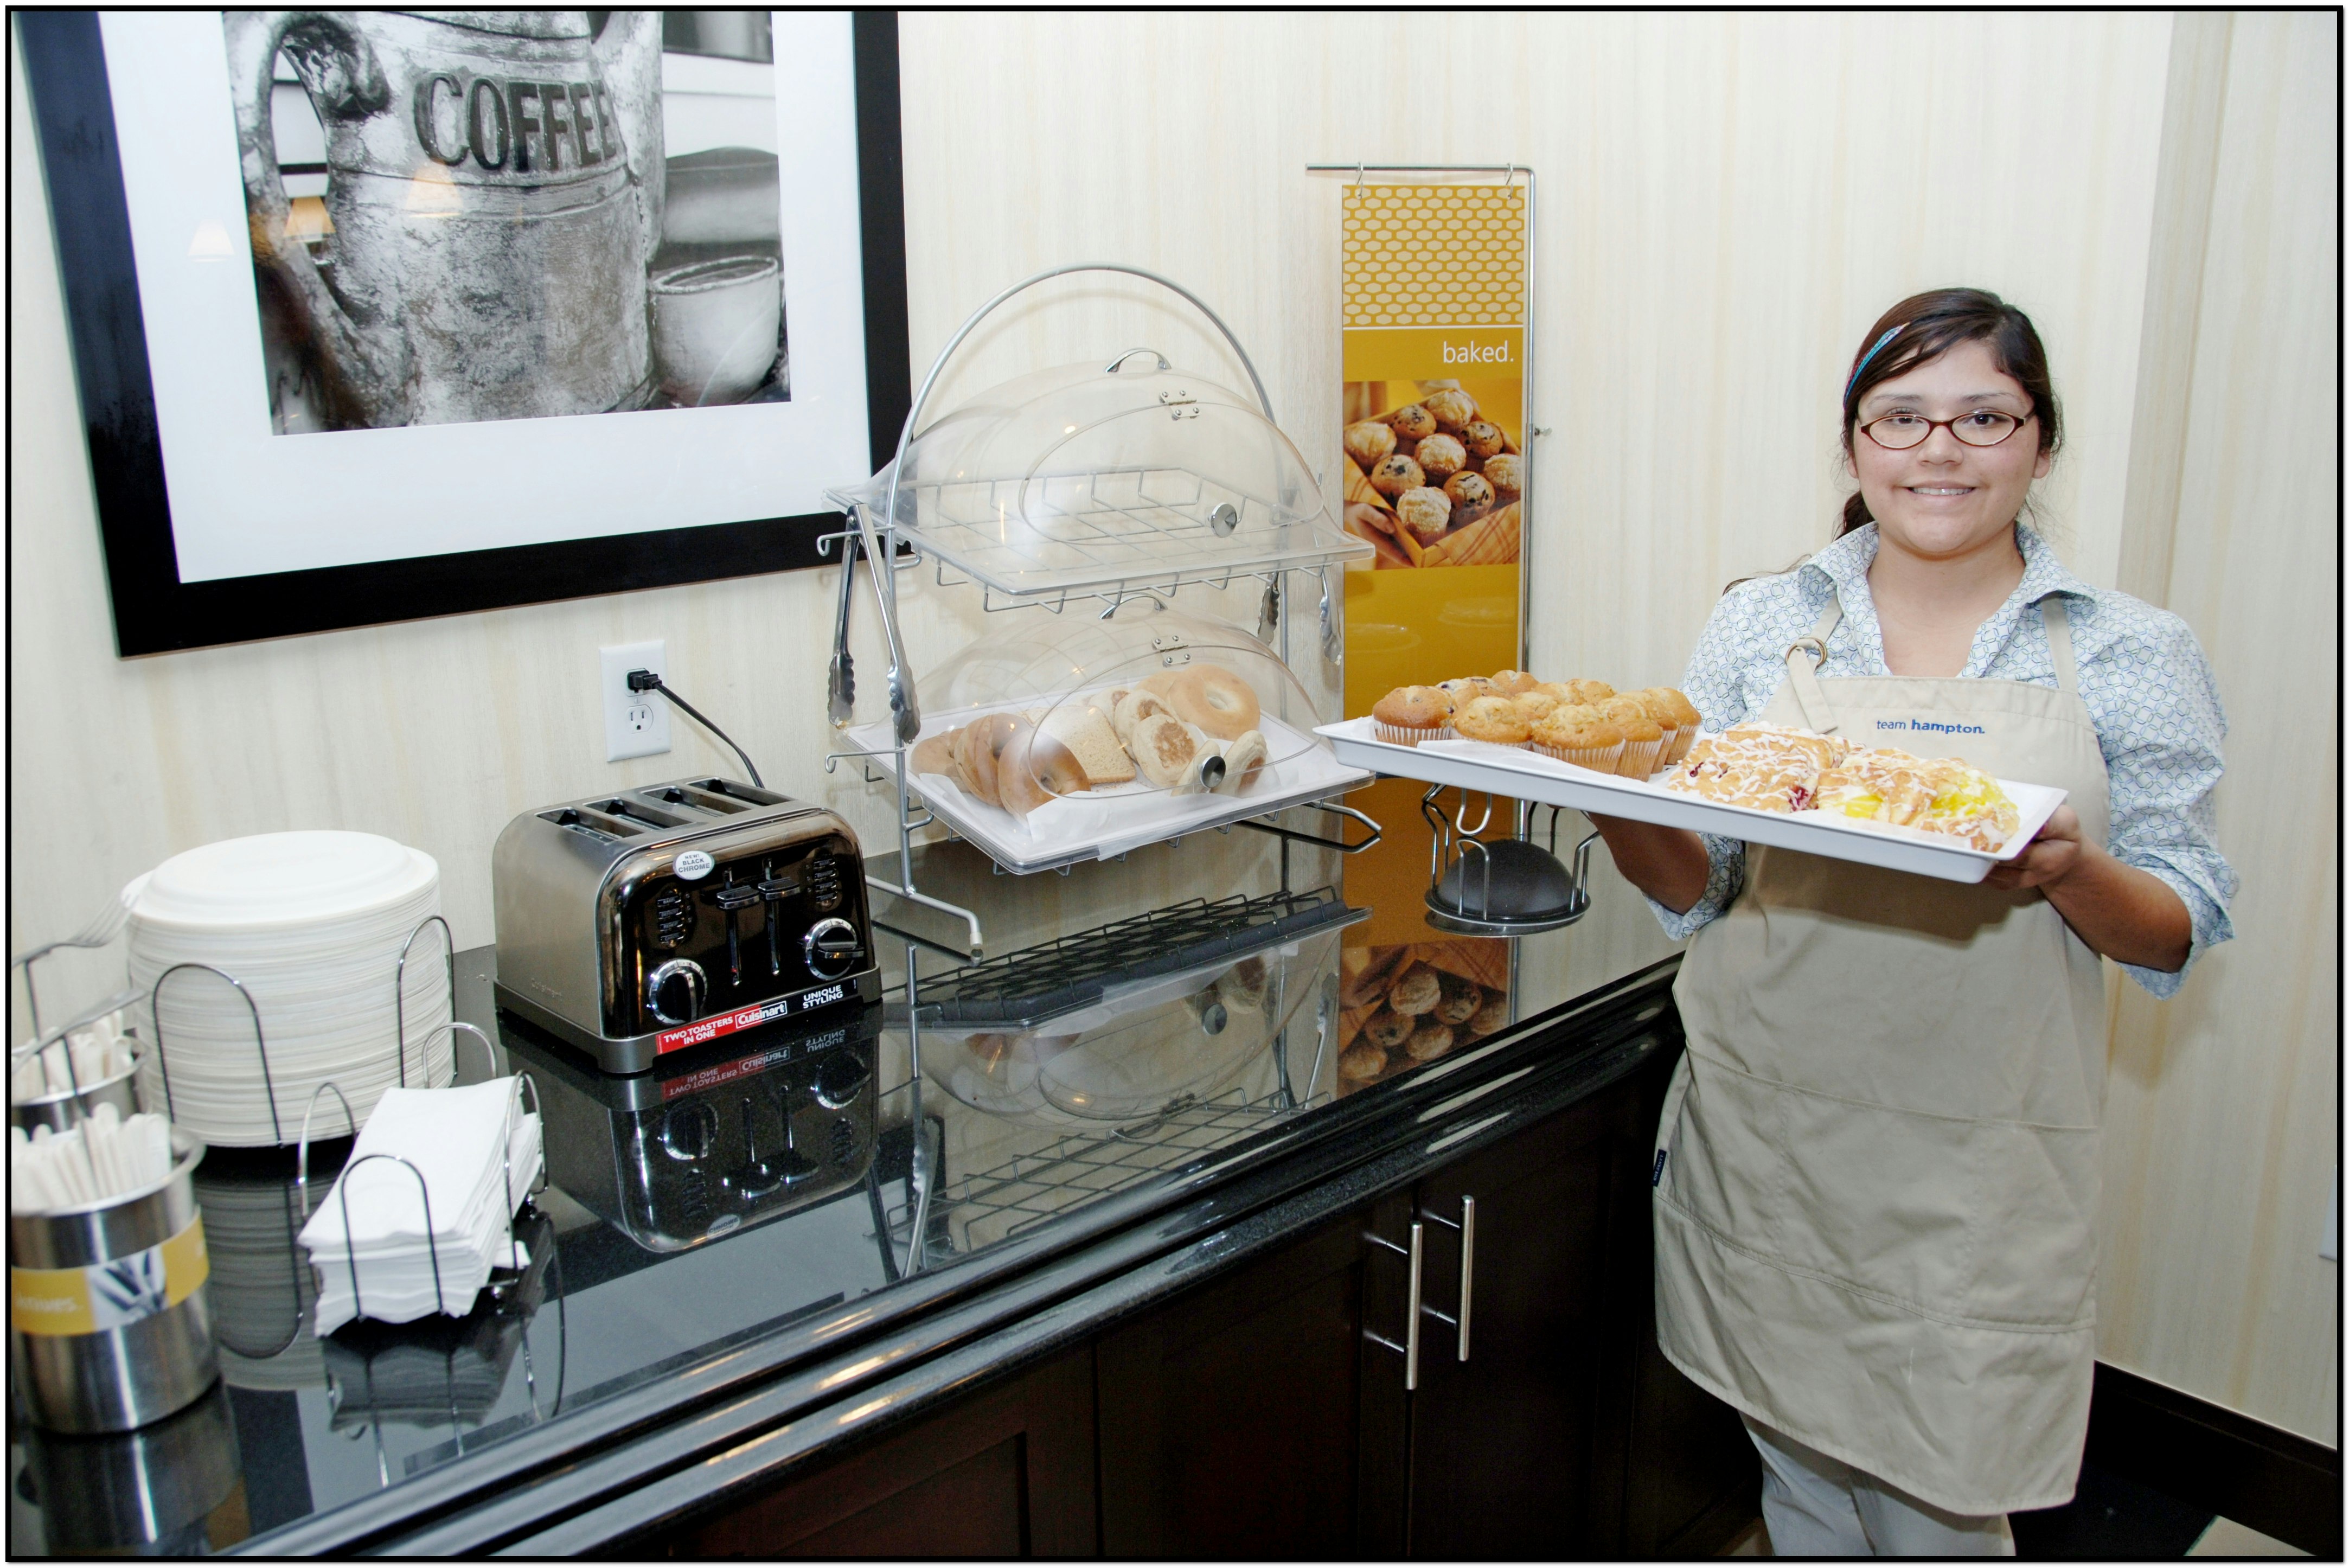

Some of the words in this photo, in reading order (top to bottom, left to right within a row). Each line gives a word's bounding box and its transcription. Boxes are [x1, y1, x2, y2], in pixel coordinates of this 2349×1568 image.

[413, 72, 617, 171] COFFEE
[1443, 340, 1514, 363] baked.
[1877, 720, 1906, 729] team
[1911, 719, 1985, 734] hampton.
[679, 863, 710, 873] CHROME
[803, 985, 841, 1001] UNIQUE
[803, 991, 843, 1009] STYLING
[738, 1004, 785, 1025] Cuisinart
[664, 1031, 687, 1042] TWO
[687, 1016, 733, 1034] TOASTERS
[683, 1035, 694, 1045] IN
[696, 1029, 716, 1041] ONE
